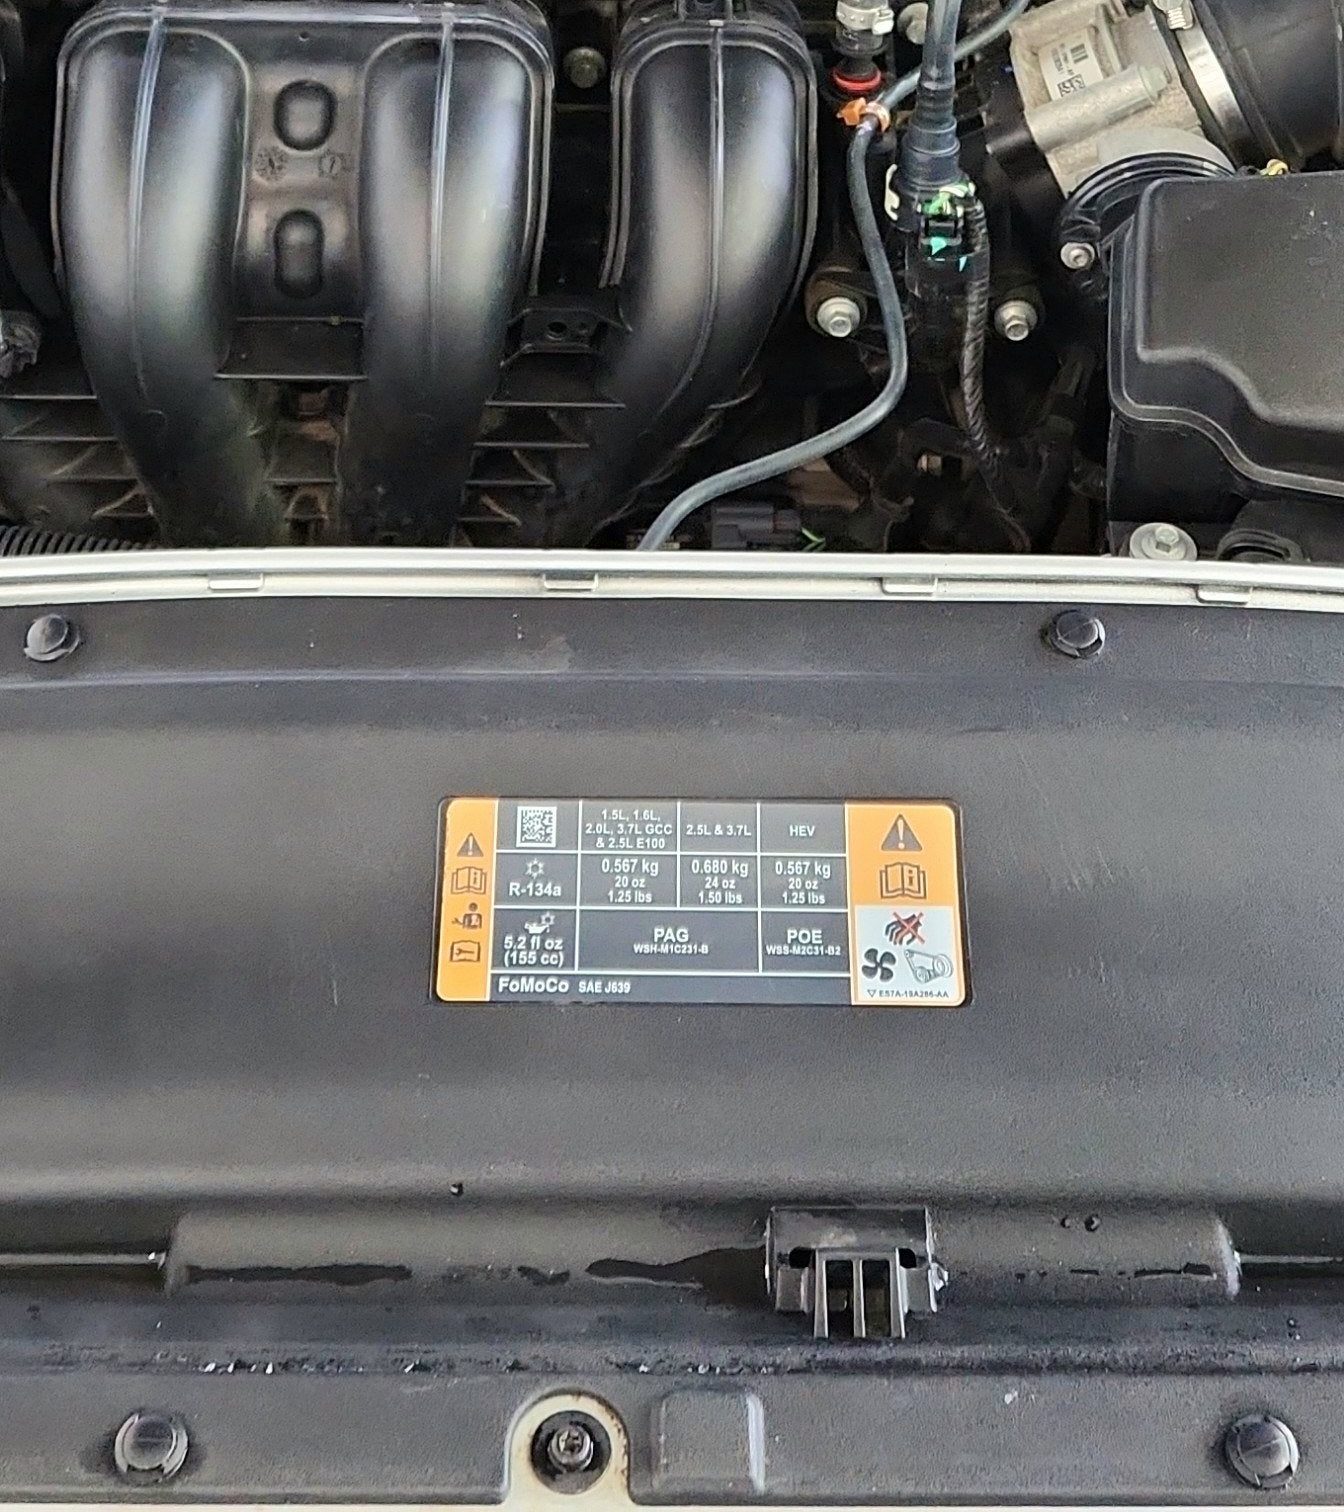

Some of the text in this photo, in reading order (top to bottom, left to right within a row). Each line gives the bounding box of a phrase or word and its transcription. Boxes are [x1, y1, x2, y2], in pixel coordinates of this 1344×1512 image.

[585, 823, 673, 836] 2.0L, 3.7L GCC
[686, 825, 752, 837] 2.5L & 3.7L
[789, 825, 816, 837] HEV
[596, 838, 666, 849] & 2.5L E100
[601, 858, 659, 875] 0.567 kg
[691, 859, 749, 877] 0.680 kg
[775, 861, 831, 879] 0.567 kg
[614, 876, 646, 888] 20 oz
[704, 877, 736, 889] 24 oz
[788, 878, 819, 890] 20 oz
[508, 882, 562, 897] R-134a
[607, 890, 653, 903] 1.25 lbs
[698, 892, 743, 904] 1.50 lbs
[782, 892, 826, 905] 1.25 lbs
[653, 928, 690, 943] PAG
[787, 929, 823, 944] POE
[503, 936, 563, 950] 5.2 fl oz
[633, 944, 710, 955] WSH-M1C231-B
[766, 945, 841, 956] WSS-M2C31-B2
[504, 952, 564, 968] (155 cc)
[498, 976, 632, 994] FoMoCo SAE J639
